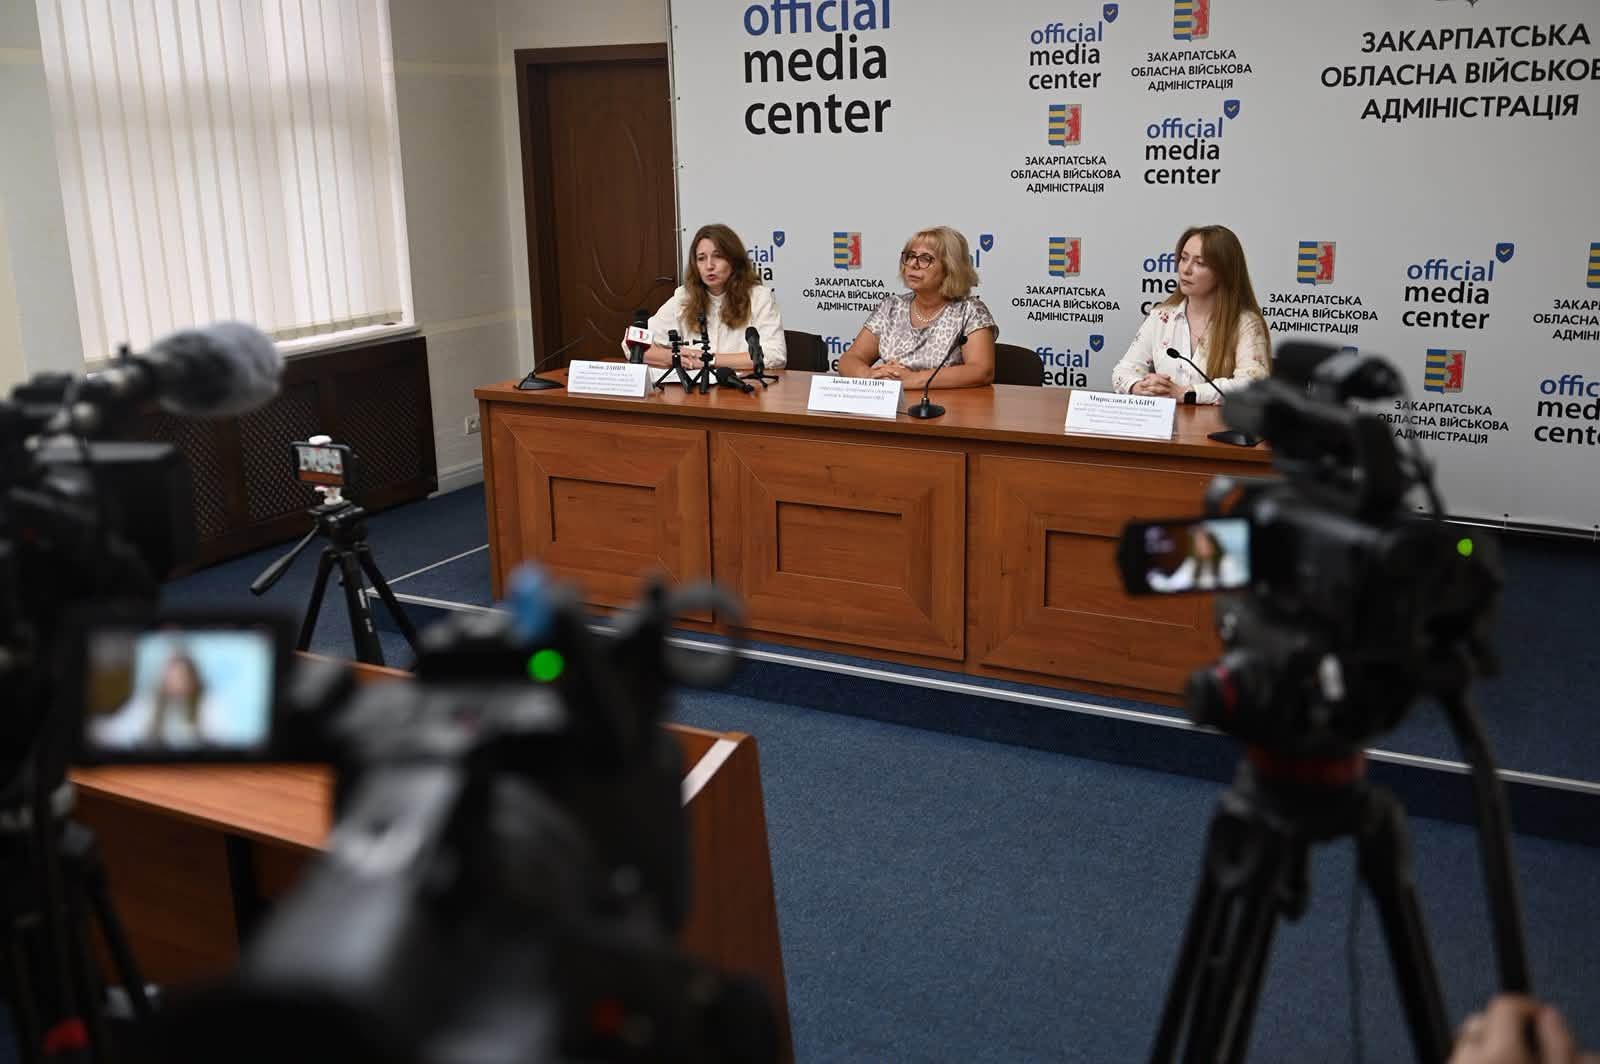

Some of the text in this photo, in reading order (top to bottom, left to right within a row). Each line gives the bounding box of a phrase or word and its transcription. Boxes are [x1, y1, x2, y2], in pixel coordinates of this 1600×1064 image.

[1030, 21, 1103, 45] official
[1361, 23, 1591, 53] ЗАКАРПАТСЬКА
[744, 33, 887, 83] media
[1029, 43, 1100, 67] media
[1147, 49, 1236, 62] ЗАКАРПАТСЬКА
[1131, 63, 1252, 77] ОБЛАСНА ВІЙСЬКОВА
[1321, 57, 1600, 87] ОБЛАСНА ВІЙСЬКОВ
[1028, 70, 1101, 90] center
[1148, 79, 1233, 92] АДМІНІСТРАЦІЯ
[745, 93, 891, 135] center
[1361, 94, 1579, 123] АДМІНІСТРАЦІЯ
[1146, 117, 1223, 139] official
[1145, 138, 1220, 160] media
[1025, 156, 1107, 166] ЗАКАРПАТСЬКА
[1010, 168, 1121, 179] ОБЛАСНА ВІЙСЬКОВА
[1144, 165, 1221, 184] center
[1026, 183, 1105, 194] АДМІНІСТРАЦІЯ
[1143, 253, 1178, 272] offi
[1407, 258, 1495, 282] official
[815, 278, 885, 288] ЗАКАРПАТСЬКА
[1025, 286, 1106, 297] ЗАКАРПАТСЬКА
[1404, 281, 1489, 304] media
[802, 289, 896, 300] ОБЛАСНА ВІЙСЬКОВ
[1269, 293, 1362, 306] ЗАКАРПАТСЬКА
[1011, 298, 1121, 311] ОБЛАСНА ВІЙСЬКОВА
[1262, 307, 1378, 321] БЛАСНА ВІЙСЬКОВА
[1027, 312, 1104, 323] АДМІНІСТРАЦІЯ
[1402, 309, 1490, 329] center
[1533, 313, 1599, 325] ОБЛАСНА
[1270, 321, 1359, 335] АДМІНІСТРАЦІЯ
[1036, 347, 1090, 368] fficial
[1043, 367, 1087, 387] edia
[1540, 374, 1600, 397] offic
[1394, 400, 1492, 416] ЗАКАРПАТСЬКА
[1536, 398, 1600, 420] med
[1439, 416, 1509, 431] ВІЙСЬКОВА
[1394, 428, 1489, 444] АДМІНІСТРАЦІЯ
[1533, 425, 1600, 446] cent
